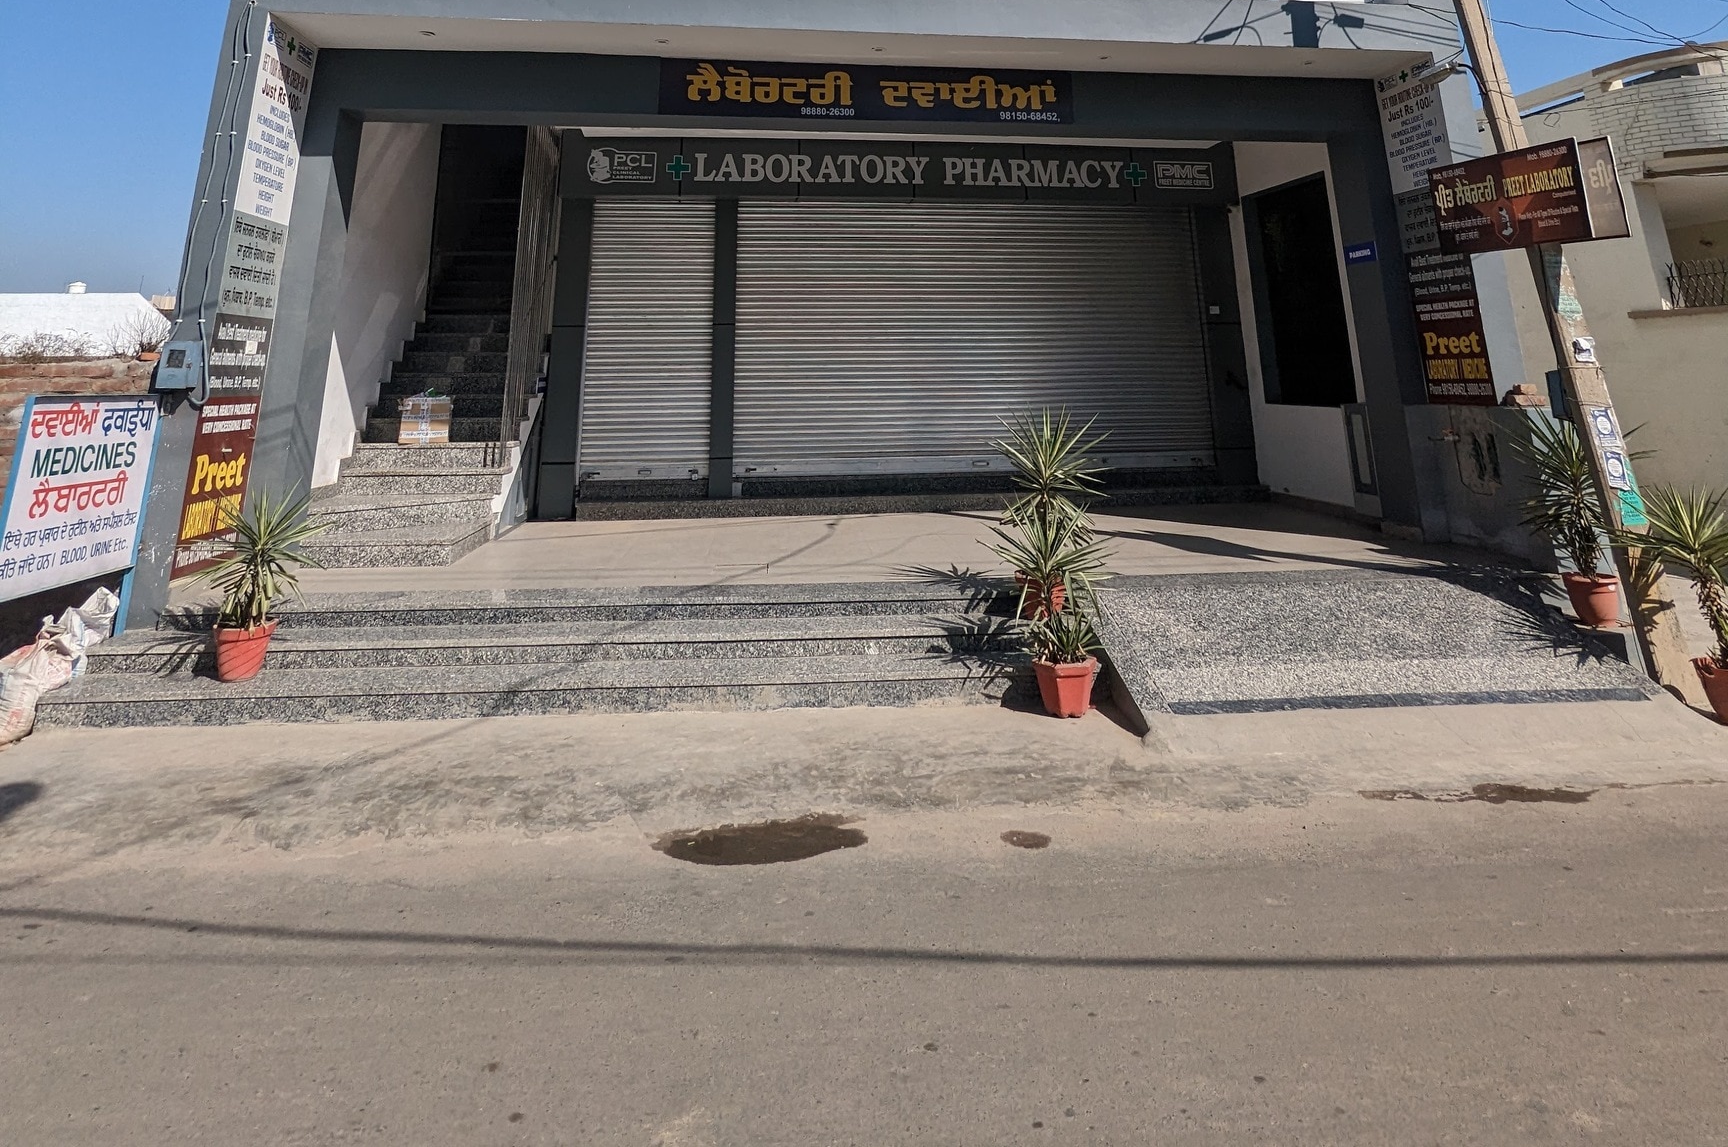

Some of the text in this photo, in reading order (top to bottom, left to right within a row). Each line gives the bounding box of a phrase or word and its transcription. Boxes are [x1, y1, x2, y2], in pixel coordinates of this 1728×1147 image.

[262, 78, 276, 99] Just
[279, 87, 286, 105] Rs
[880, 75, 1056, 110] ਦਵਾਈਆਂ
[801, 107, 855, 116] 98880-26300
[1000, 112, 1060, 122] 98150-68452,
[1387, 96, 1433, 121] Just Rs 100/-
[262, 131, 288, 151] BLOOD SUGAR
[1390, 148, 1405, 158] BLOOD
[1405, 139, 1430, 153] PRESSURE
[1400, 129, 1432, 145] BLOOD SUGAR
[249, 141, 261, 153] BLOOD
[264, 147, 284, 163] PRESSURE
[614, 154, 653, 167] PCL
[1421, 147, 1435, 157] LEVEL
[694, 153, 1123, 188] LABORATORY PHARMACY
[1157, 164, 1209, 179] PMC
[1403, 156, 1437, 172] TEMPERATURE
[1502, 166, 1574, 198] PREET LABORATORY
[1423, 332, 1481, 355] Preet
[31, 402, 100, 439] ਦਵਾਈਆਂ
[31, 441, 137, 478] MEDICINES
[192, 453, 246, 494] Preet
[23, 530, 38, 547] ਹਰ
[60, 521, 69, 539] ਦੇ
[89, 515, 102, 534] ਅਤੇ
[60, 545, 87, 566] BLOOD,
[90, 540, 112, 558] URINE
[113, 537, 129, 553] Etc.
